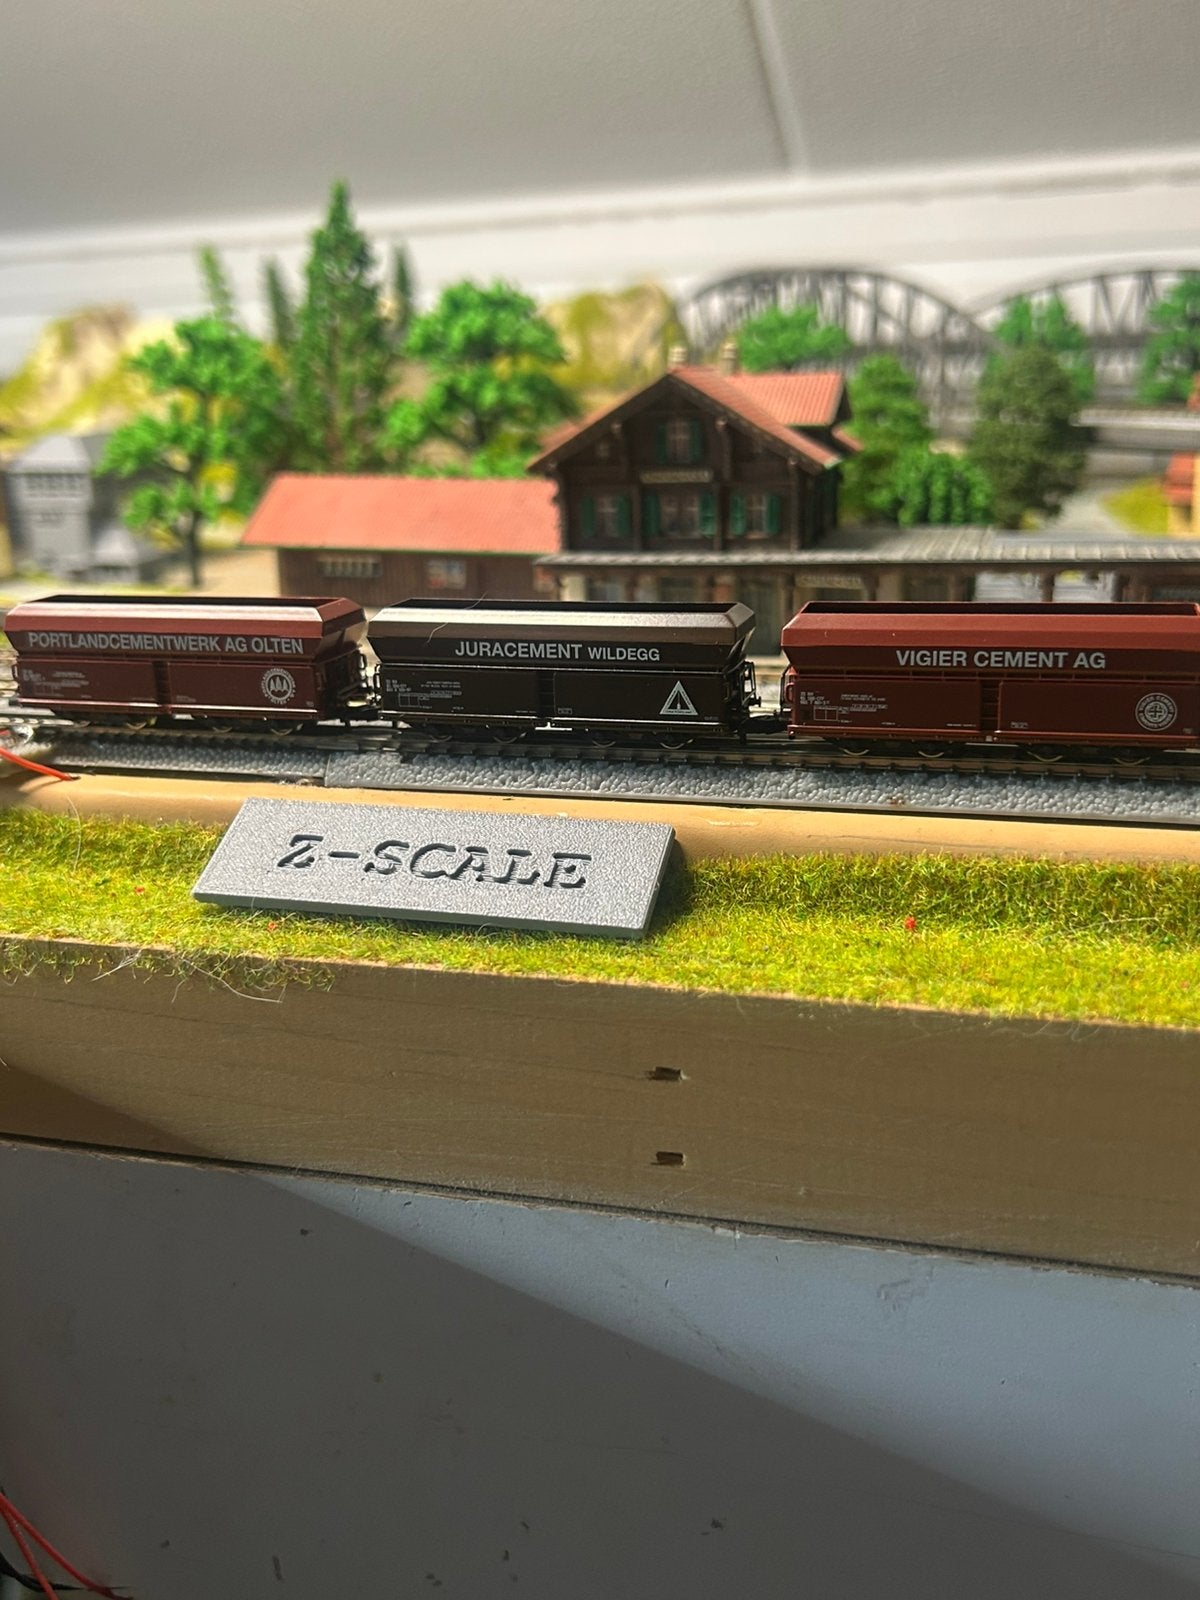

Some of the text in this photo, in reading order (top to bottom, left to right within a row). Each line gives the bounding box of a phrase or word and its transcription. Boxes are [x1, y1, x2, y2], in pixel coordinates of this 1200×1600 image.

[28, 631, 304, 655] PORTLANDCEMENTWERK AG OLTEN
[455, 640, 660, 662] JURACEMENT WILDEGG
[896, 650, 1106, 669] VIGIER CEMENT AG
[277, 834, 592, 889] Z-SCALE
